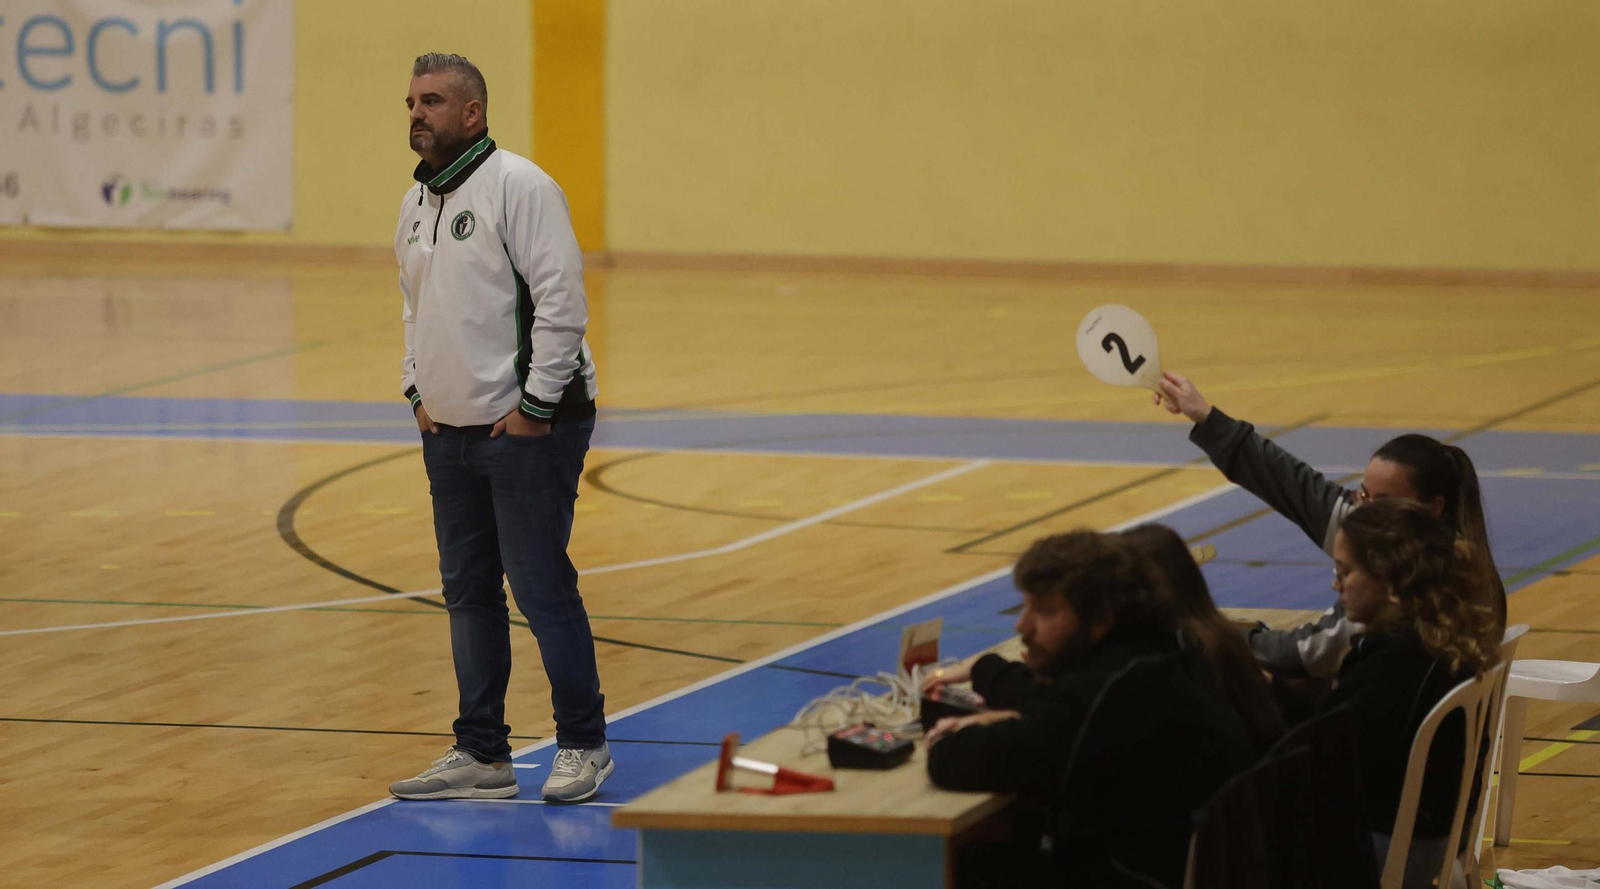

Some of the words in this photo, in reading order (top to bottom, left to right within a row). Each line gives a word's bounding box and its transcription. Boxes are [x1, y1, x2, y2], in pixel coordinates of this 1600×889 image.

[0, 0, 244, 94] ecni
[18, 103, 245, 143] Algeciras
[1101, 332, 1147, 375] 2
